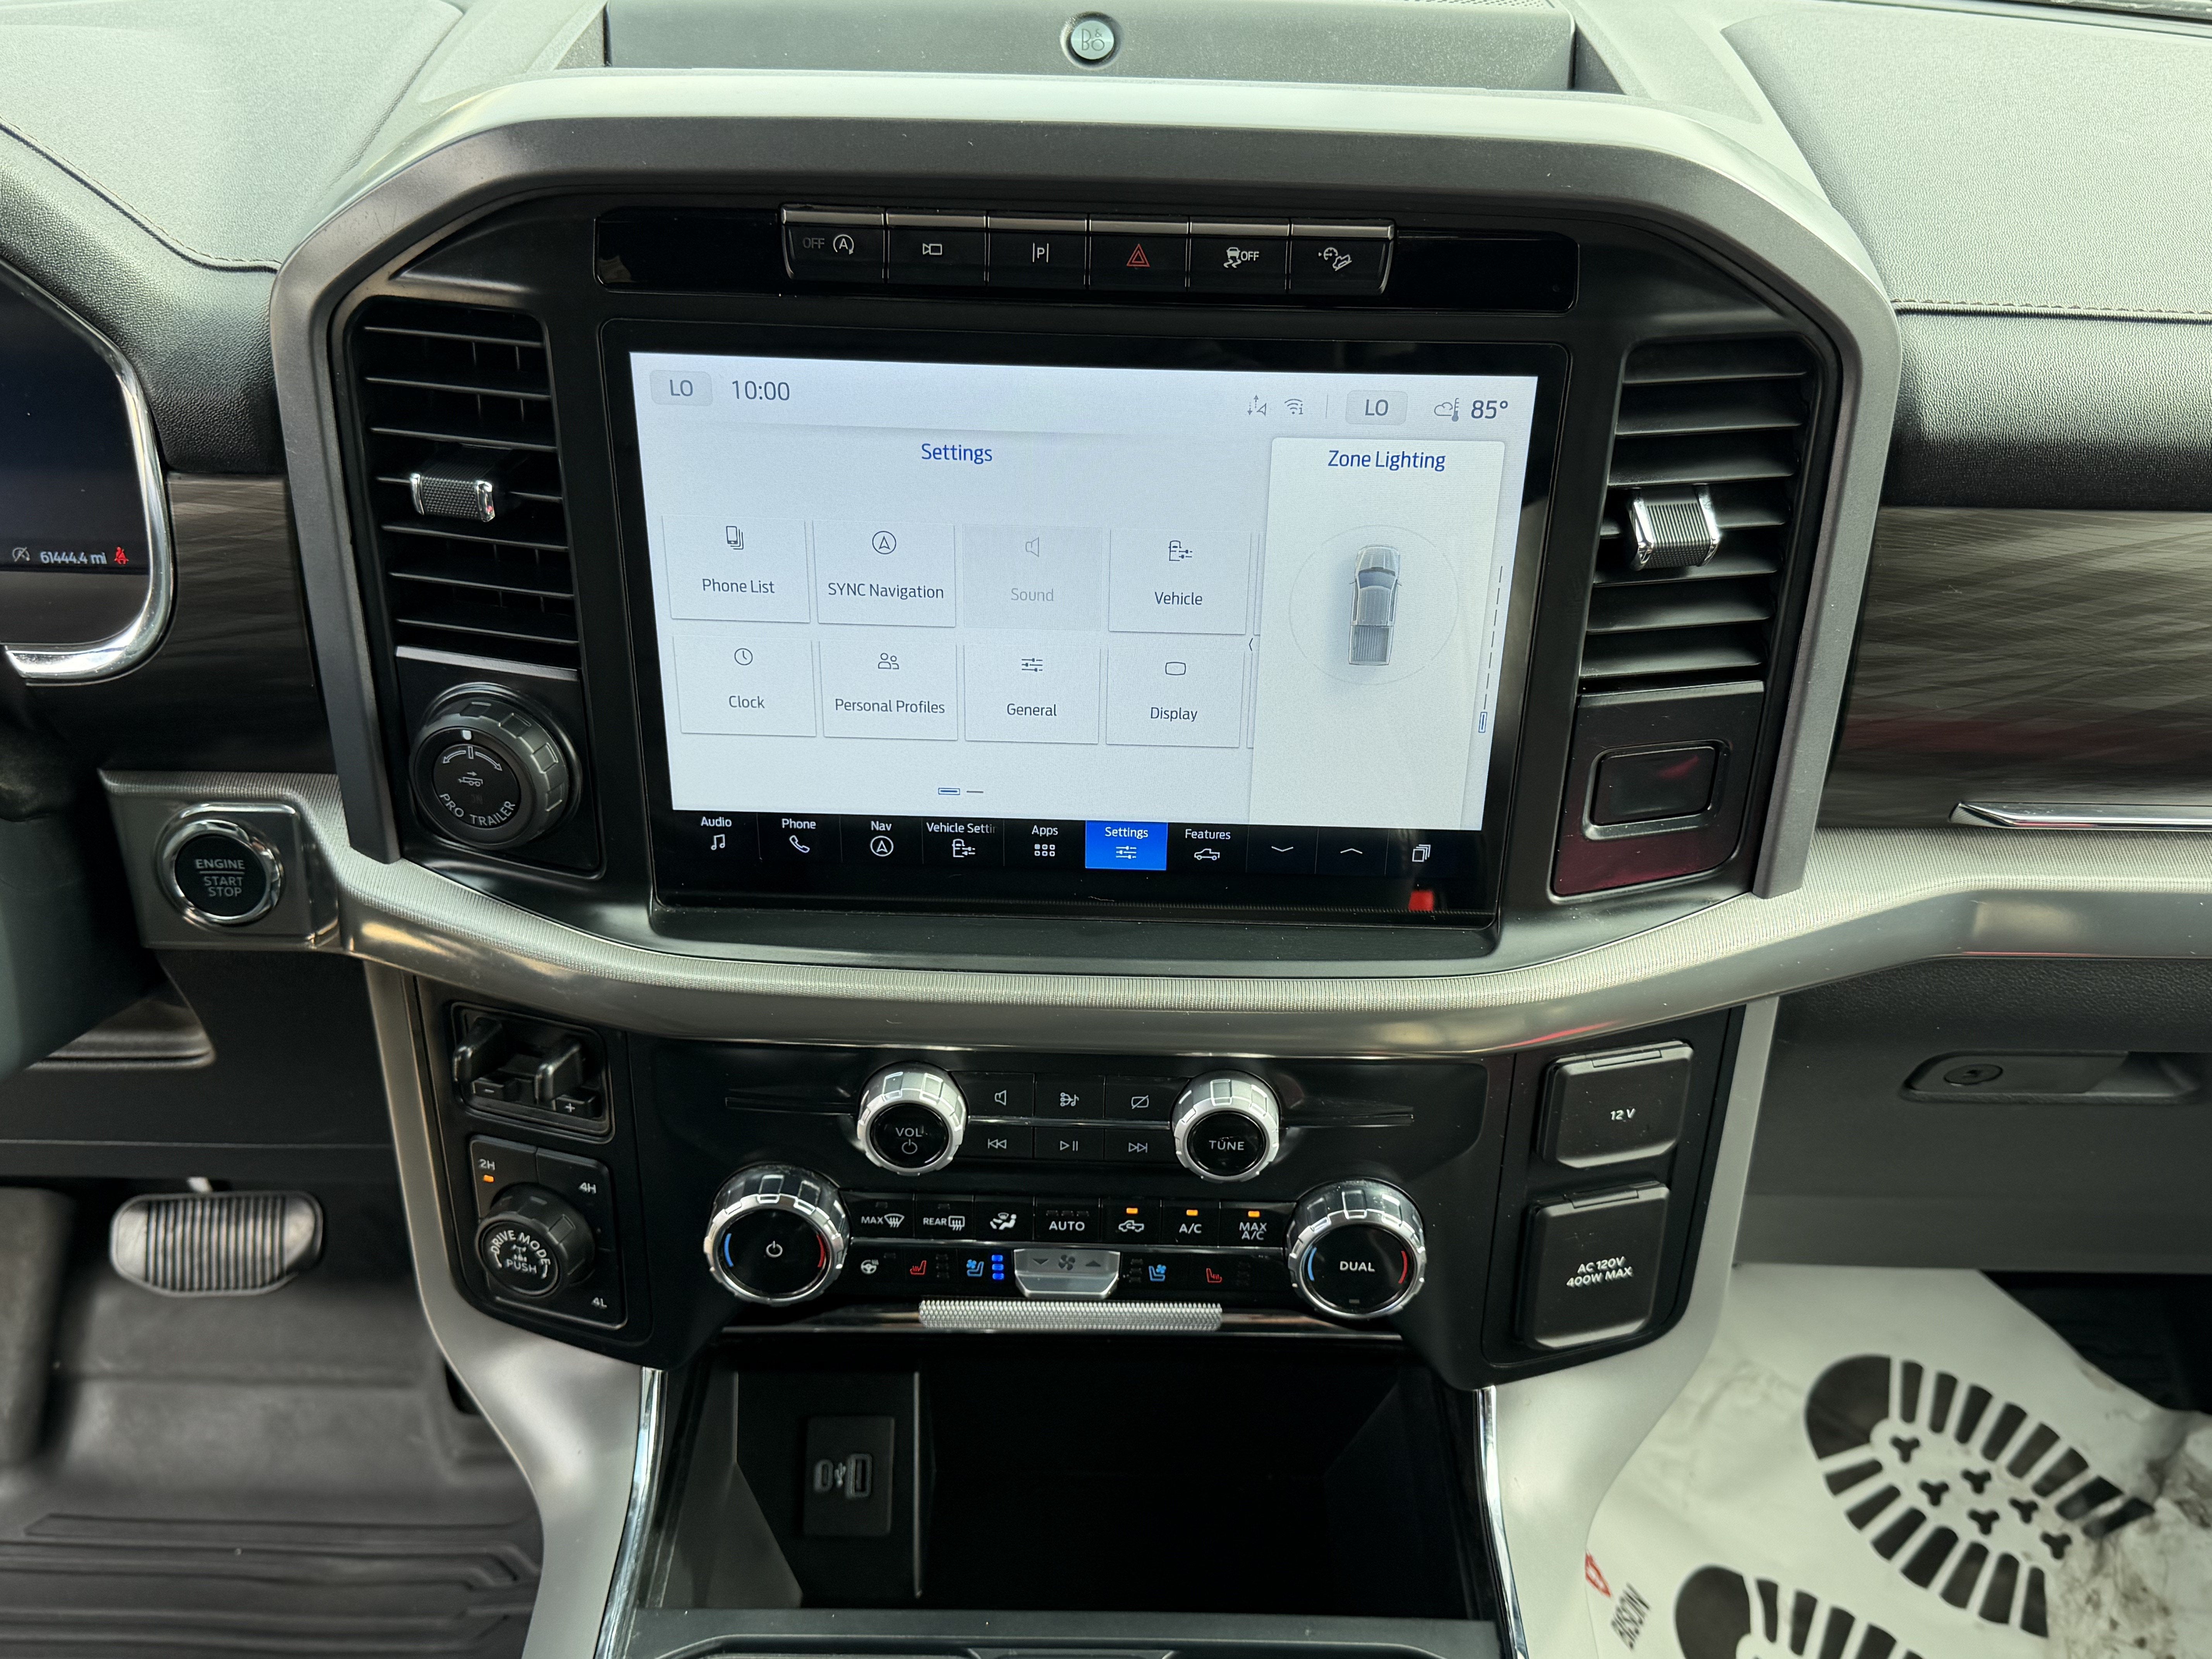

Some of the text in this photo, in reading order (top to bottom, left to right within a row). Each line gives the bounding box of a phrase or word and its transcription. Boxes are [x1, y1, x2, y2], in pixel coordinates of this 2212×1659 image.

[802, 237, 825, 249] OFF
[1240, 251, 1259, 261] OFF
[669, 380, 694, 397] LO
[732, 380, 790, 401] 10:00
[1365, 399, 1389, 416] LO
[1471, 400, 1508, 419] 85°
[921, 443, 993, 464] Settings
[1328, 450, 1446, 472] Zone Lighting
[40, 551, 107, 564] 61444.4 mi
[702, 578, 775, 594] Phone List
[828, 582, 944, 600] SYNC Navigation
[1010, 587, 1054, 603] Sound
[1154, 591, 1203, 606] Vehicle
[728, 695, 765, 709] Clock
[835, 698, 945, 714] Personal Profiles
[1006, 703, 1057, 717] General
[1150, 706, 1198, 722] Display
[440, 793, 464, 817] PRO
[469, 801, 515, 826] TRAILER
[701, 816, 732, 828] Audio
[781, 818, 816, 830] Phone
[871, 821, 892, 832] Nav
[926, 822, 965, 833] Vehicle
[1031, 825, 1058, 836] Apps
[1105, 826, 1149, 840] Settings
[1185, 829, 1231, 840] Features
[195, 859, 246, 870] ENGINE
[203, 876, 243, 886] START
[208, 886, 242, 897] STOP
[1610, 1108, 1636, 1121] 12 V
[895, 1127, 922, 1137] VOL
[1208, 1140, 1245, 1151] TUNE
[478, 1159, 495, 1171] 2H
[579, 1182, 596, 1194] 4H
[861, 1216, 884, 1225] MAX
[923, 1218, 947, 1226] REAR
[1048, 1221, 1085, 1231] AUTO
[1179, 1223, 1202, 1234] A/C
[1239, 1222, 1267, 1232] MAX
[1241, 1230, 1265, 1241] A/C
[490, 1230, 551, 1265] DRIVE MODE
[506, 1259, 537, 1274] PUSH
[1339, 1261, 1375, 1272] DUAL
[1577, 1256, 1626, 1275] AC 120V
[1566, 1266, 1634, 1288] 400W MAX
[591, 1297, 607, 1309] 4L
